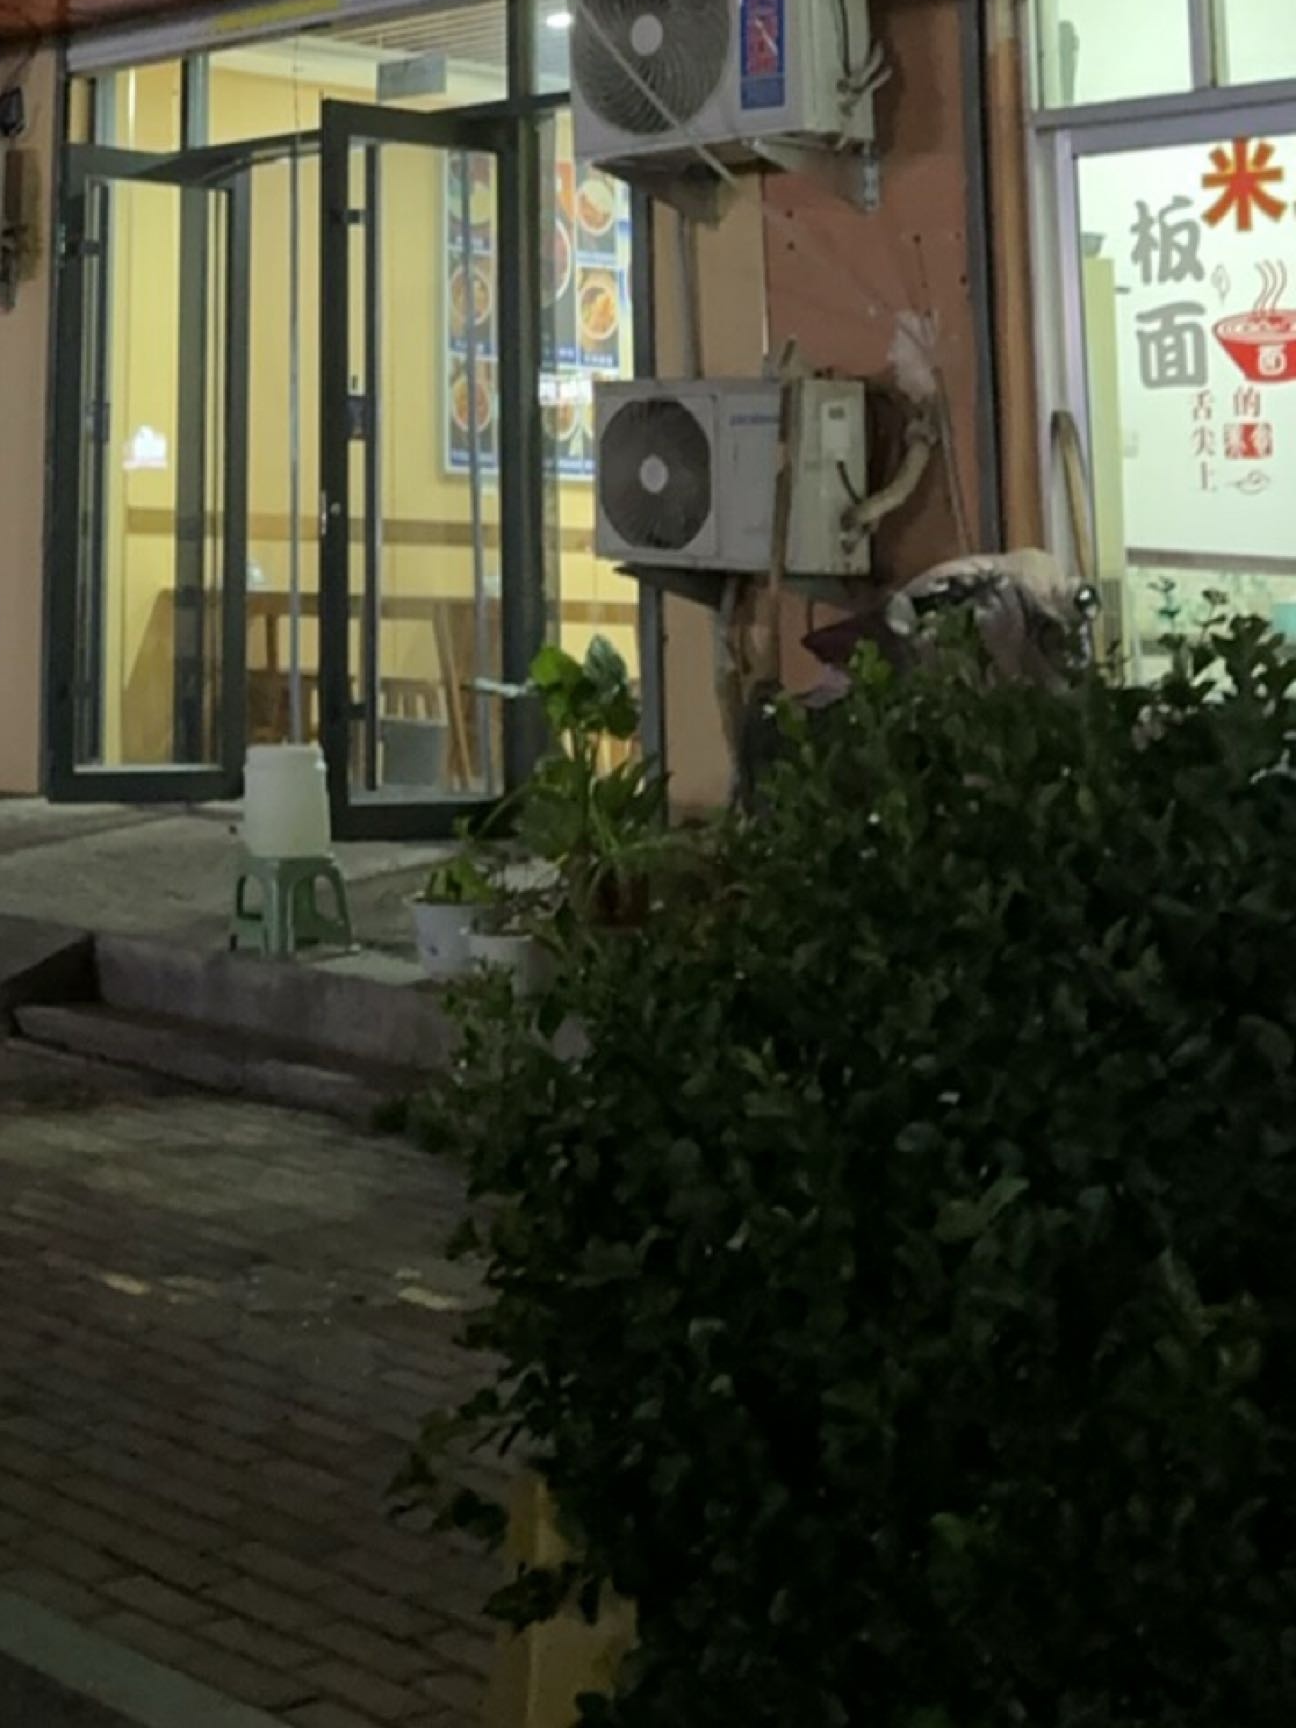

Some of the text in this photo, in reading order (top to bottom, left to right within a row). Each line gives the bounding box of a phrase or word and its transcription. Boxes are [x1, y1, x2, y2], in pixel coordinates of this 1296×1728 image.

[1201, 135, 1286, 233] 米
[1129, 195, 1210, 390] 板面
[1191, 388, 1219, 494] 舌尖上
[1232, 386, 1262, 419] 的
